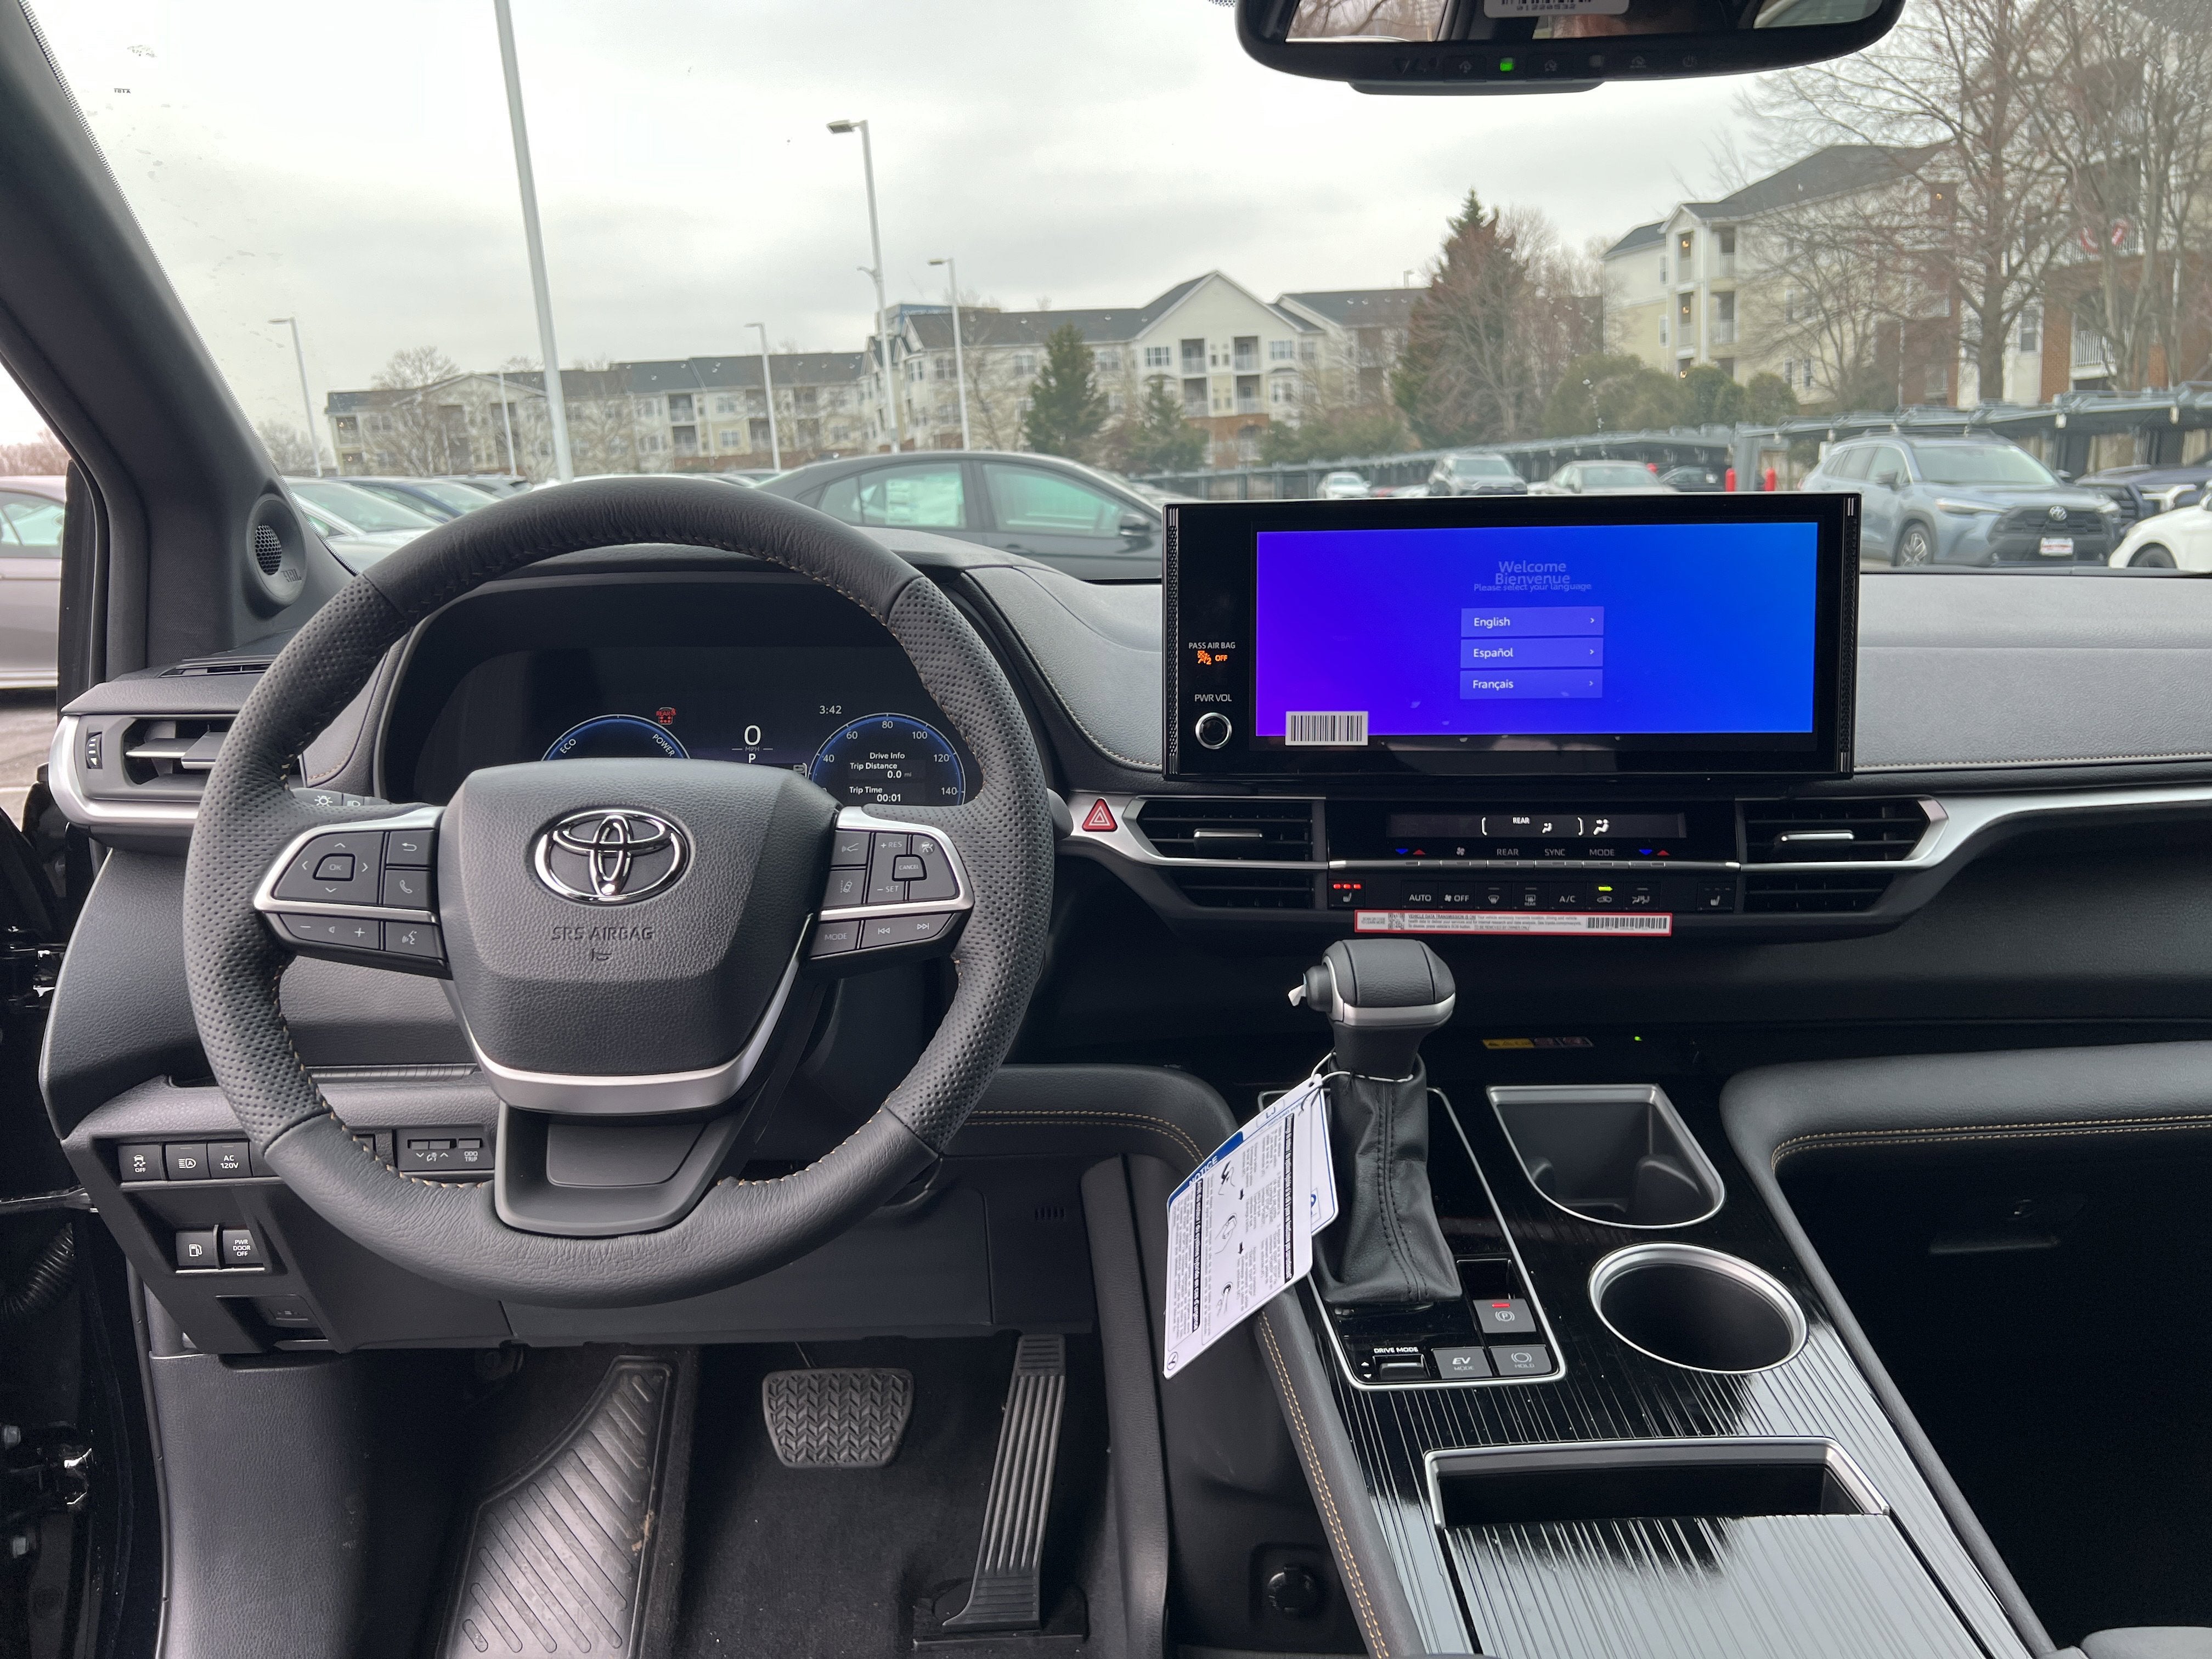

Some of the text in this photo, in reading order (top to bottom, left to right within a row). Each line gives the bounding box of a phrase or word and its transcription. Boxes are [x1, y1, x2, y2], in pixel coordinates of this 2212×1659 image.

[1498, 560, 1566, 573] Welcome
[281, 568, 302, 583] JBL
[1495, 573, 1570, 585] Bienvenue
[1530, 584, 1548, 592] your
[1550, 582, 1592, 592] language
[1474, 617, 1510, 629] English
[1473, 648, 1514, 659] Español
[1472, 679, 1514, 691] Français
[1215, 693, 1232, 702] VOL
[819, 705, 842, 714] 3:42
[882, 720, 893, 729] 80
[744, 725, 761, 746] 0
[846, 731, 858, 740] 60
[912, 731, 928, 740] 100
[560, 738, 577, 754] ECO
[652, 733, 675, 757] POWER
[748, 753, 756, 764] P
[823, 754, 835, 763] 40
[933, 753, 950, 762] 120
[850, 763, 864, 771] Trip
[887, 770, 902, 779] 0.0
[849, 787, 864, 795] Trip
[941, 787, 957, 795] 140
[877, 793, 901, 802] 00:01
[1497, 848, 1519, 856] REAR
[1544, 848, 1566, 856] SYNC
[1589, 848, 1615, 857] MODE
[1409, 894, 1431, 902] AUTO
[552, 927, 654, 941] SRS AIRBAG
[1266, 1107, 1276, 1119] LJ
[1189, 1155, 1218, 1186] NOTICE
[1452, 1357, 1471, 1365] EV
